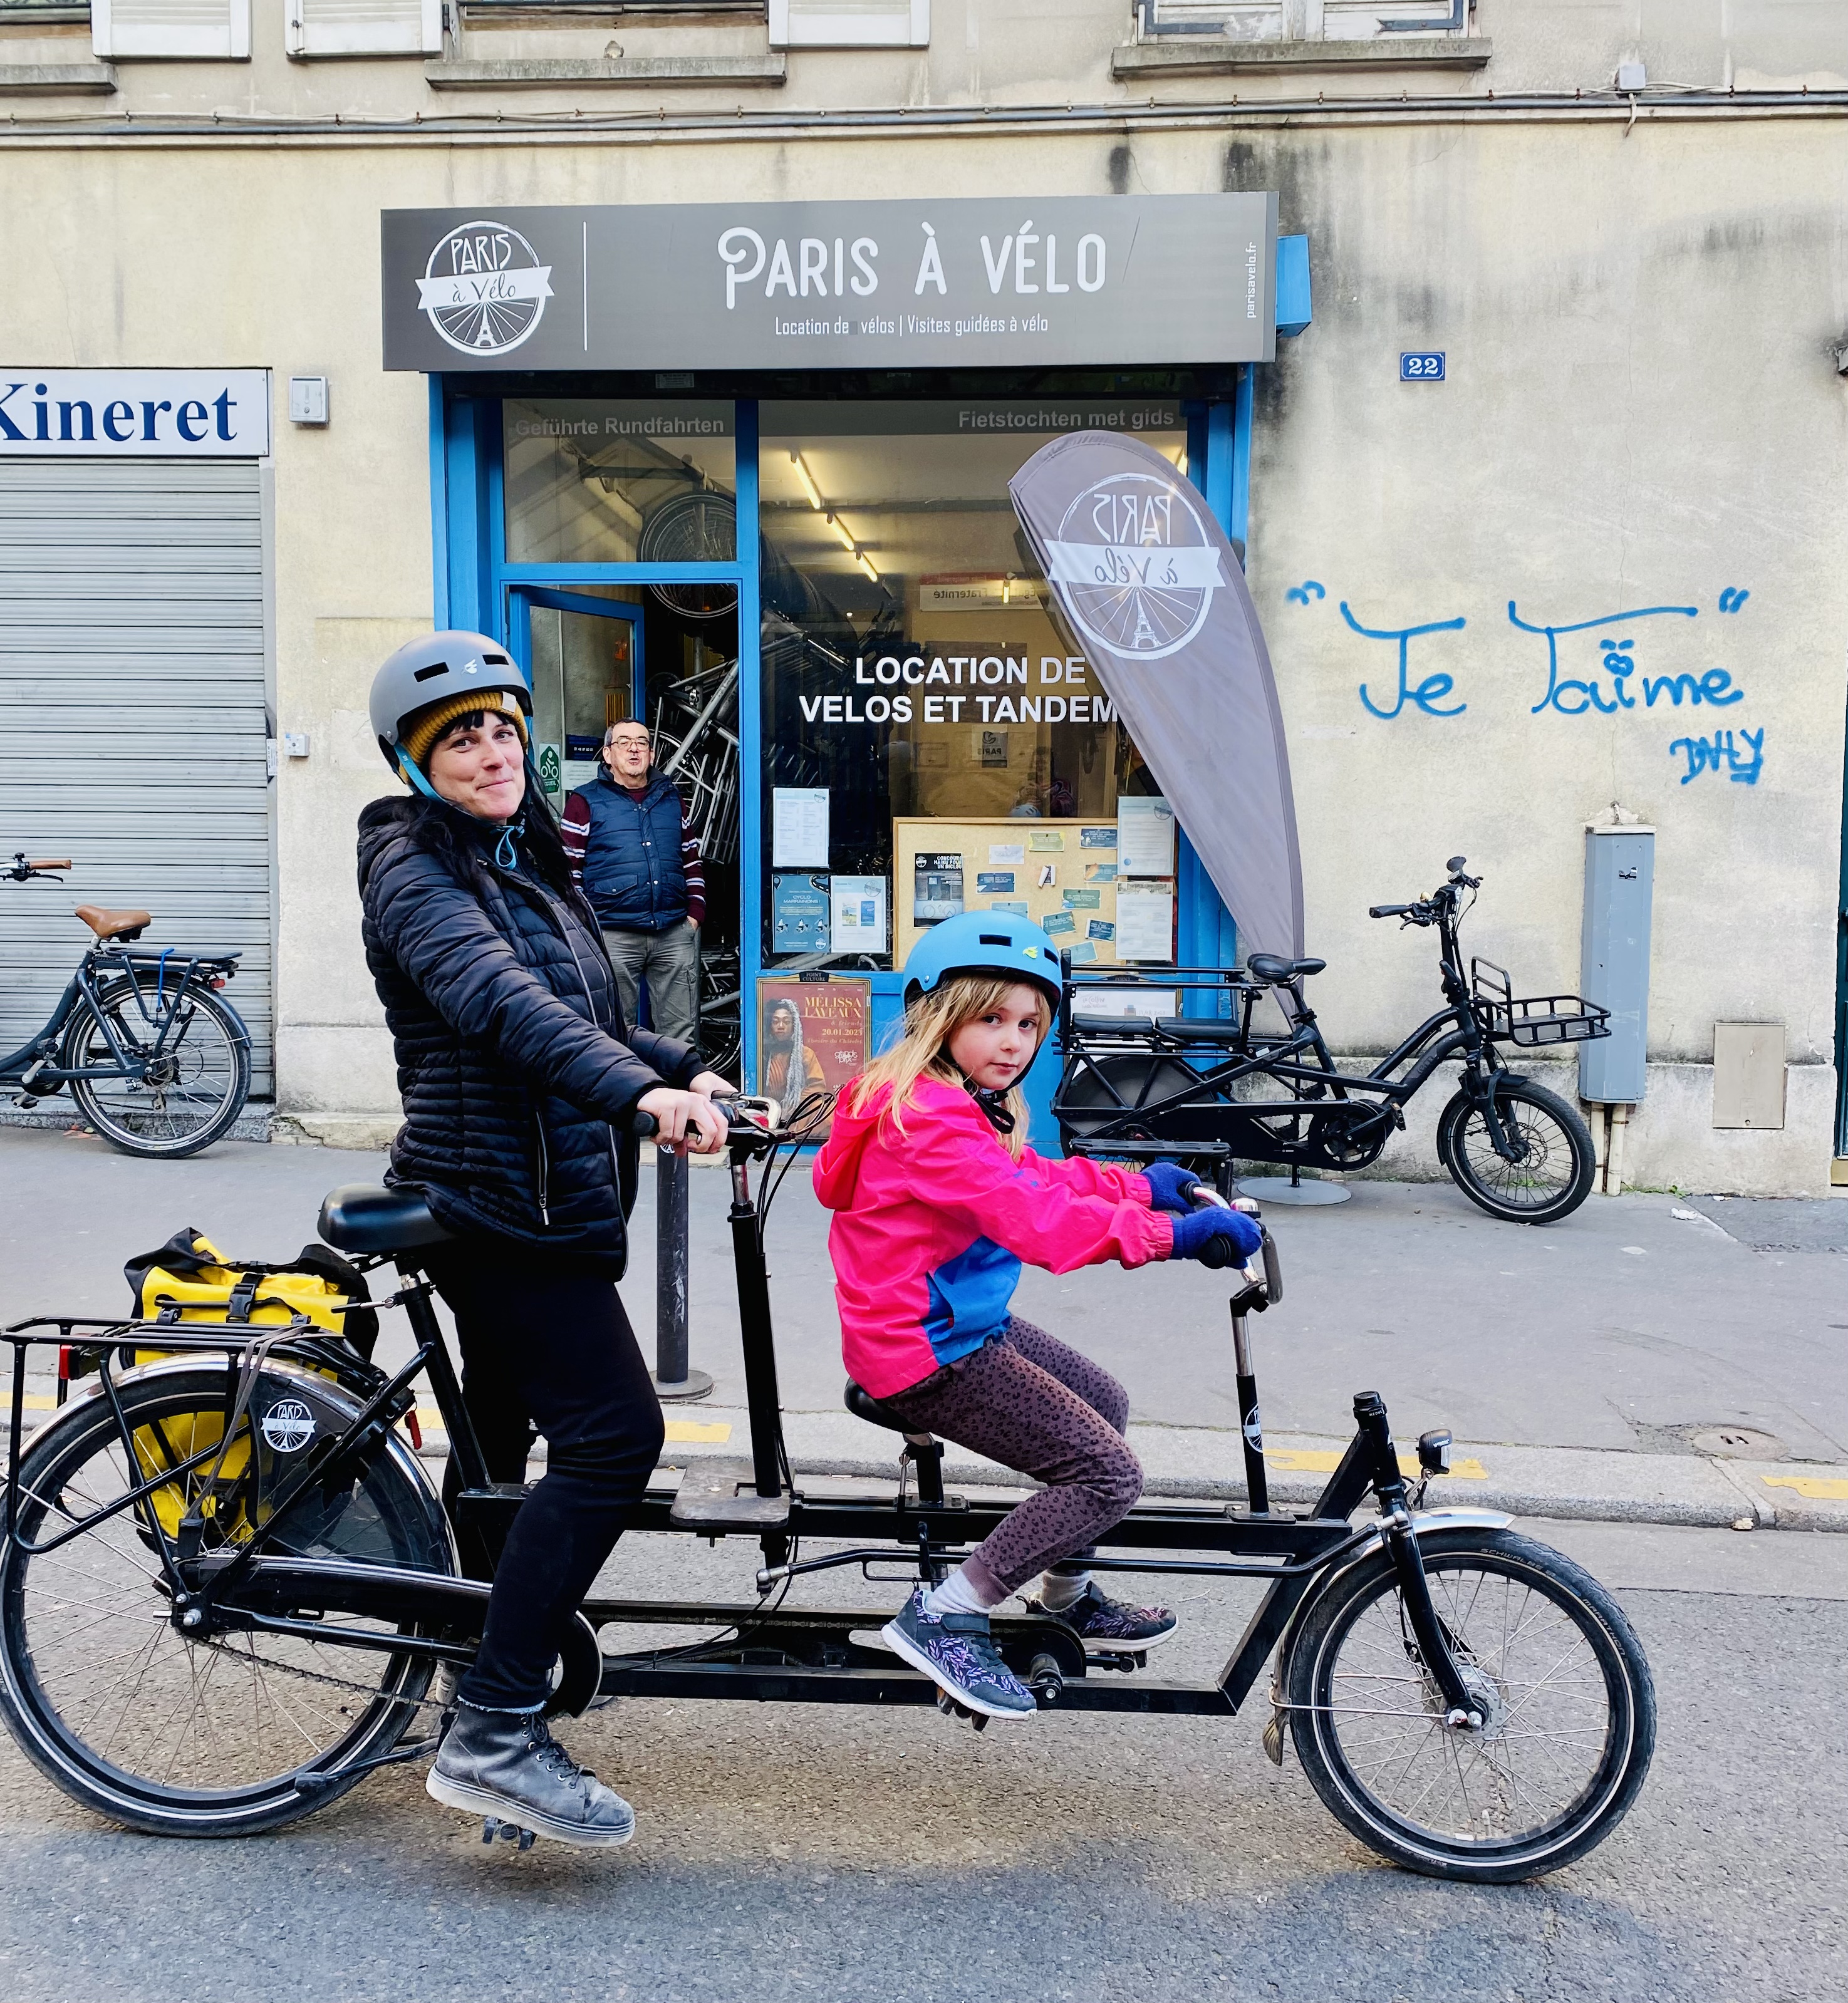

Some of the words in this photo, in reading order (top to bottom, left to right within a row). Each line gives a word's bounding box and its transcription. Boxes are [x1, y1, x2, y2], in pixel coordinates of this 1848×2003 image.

[450, 233, 512, 275] PARIS
[717, 226, 878, 310] PARIS
[914, 221, 947, 295] À
[980, 219, 1106, 294] VÉLO
[452, 282, 466, 303] à
[472, 272, 516, 301] Vélo
[1245, 241, 1257, 319] parisavelo.fr
[775, 316, 829, 335] Location
[833, 316, 849, 334] de
[861, 315, 895, 333] vélos
[907, 314, 951, 333] Visites
[955, 314, 1005, 336] guidées
[1009, 315, 1017, 332] à
[1022, 313, 1049, 332] vélo
[1408, 357, 1440, 375] 22
[516, 418, 598, 436] Geführte
[605, 416, 725, 435] Rundfahrten
[958, 410, 1082, 428] Fietstochten
[1088, 409, 1126, 427] met
[1131, 407, 1175, 430] gids
[856, 656, 1028, 685] LOCATION
[1040, 656, 1086, 684] DE
[799, 695, 913, 723] VELOS
[924, 695, 967, 722] ET
[804, 1007, 863, 1018] LAVEAUX
[805, 993, 862, 1008] MÉLISSA
[277, 1404, 303, 1420] PARIS
[1582, 1598, 1626, 1656] MARATHON
